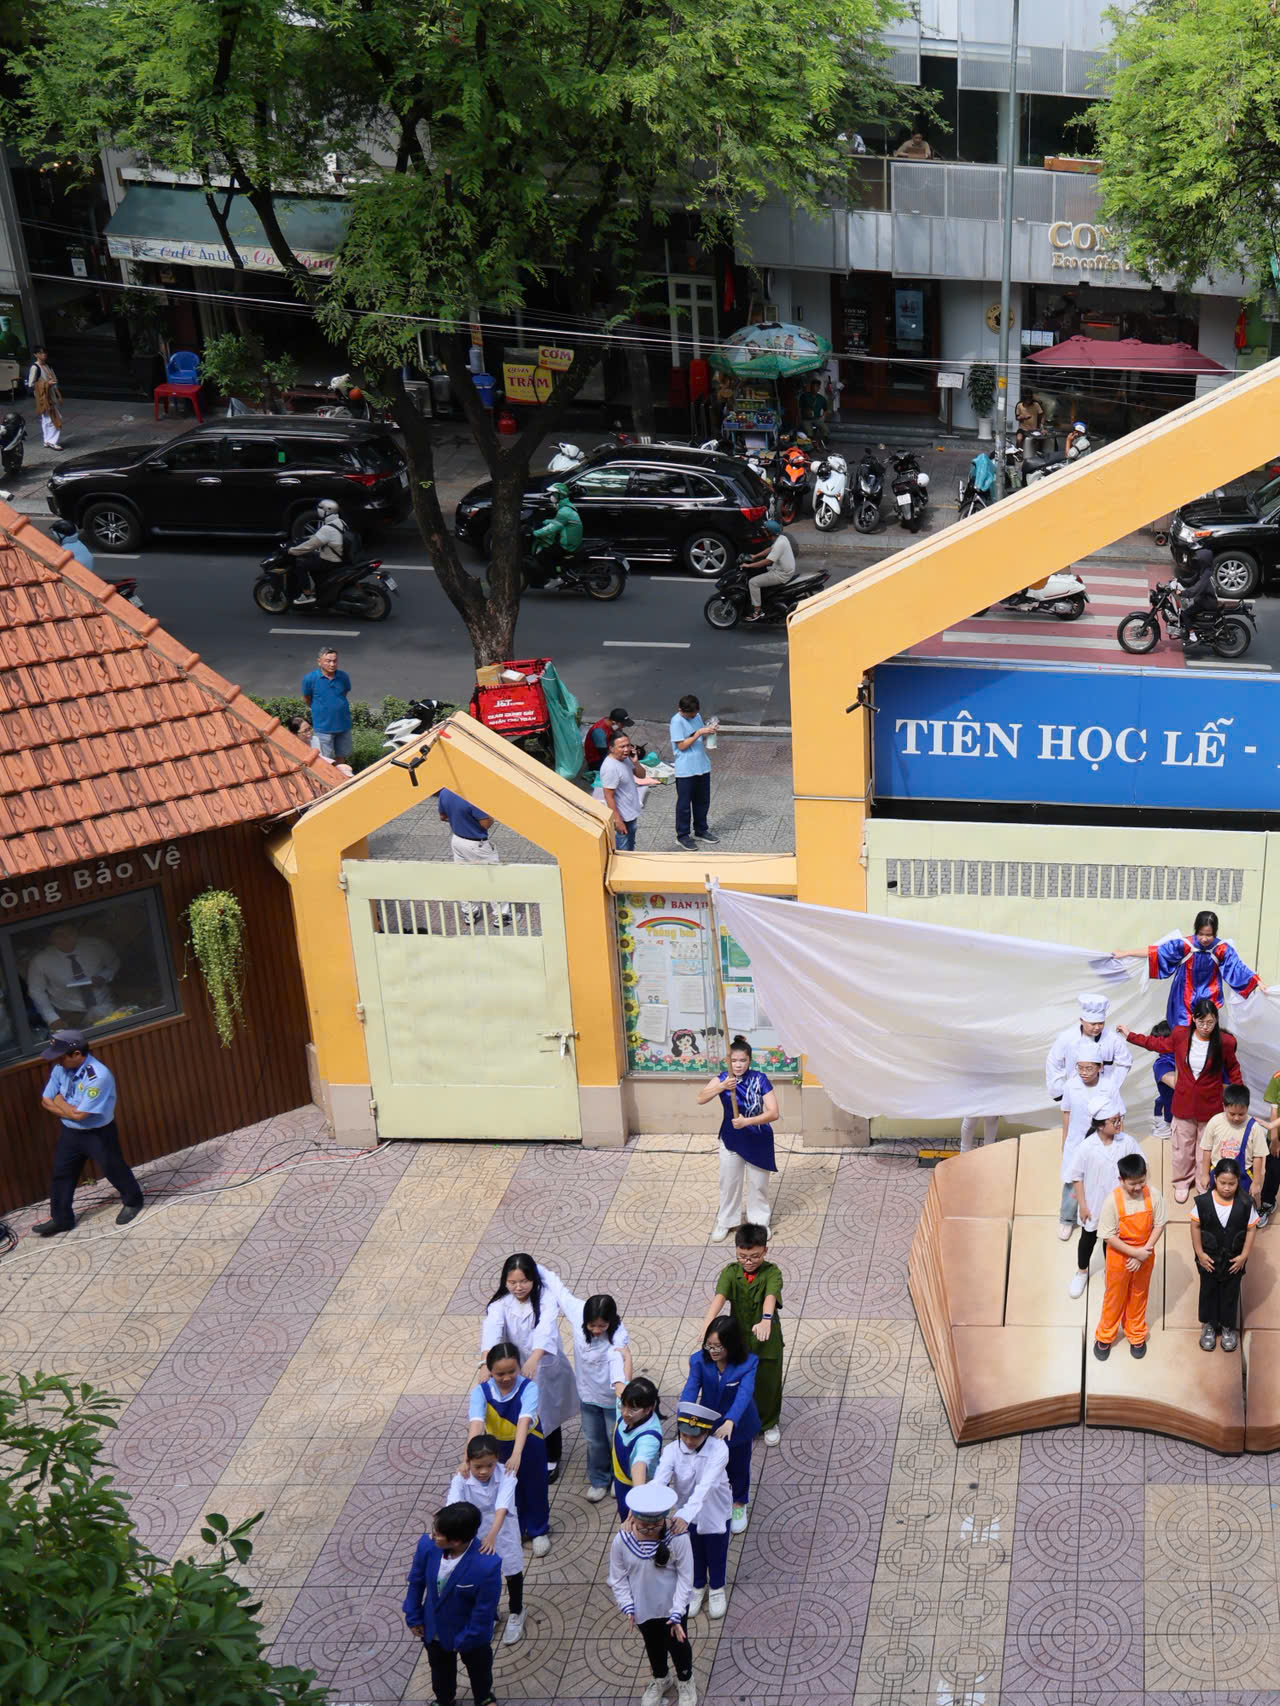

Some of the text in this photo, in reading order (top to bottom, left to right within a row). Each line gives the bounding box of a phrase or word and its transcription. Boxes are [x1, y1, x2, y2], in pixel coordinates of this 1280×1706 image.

[1052, 253, 1078, 269] Eco
[896, 710, 1022, 759] TIÊN
[1037, 724, 1147, 770] HỌC
[1161, 717, 1234, 767] LỄ
[73, 861, 133, 890] Bảo
[143, 845, 181, 871] Vệ
